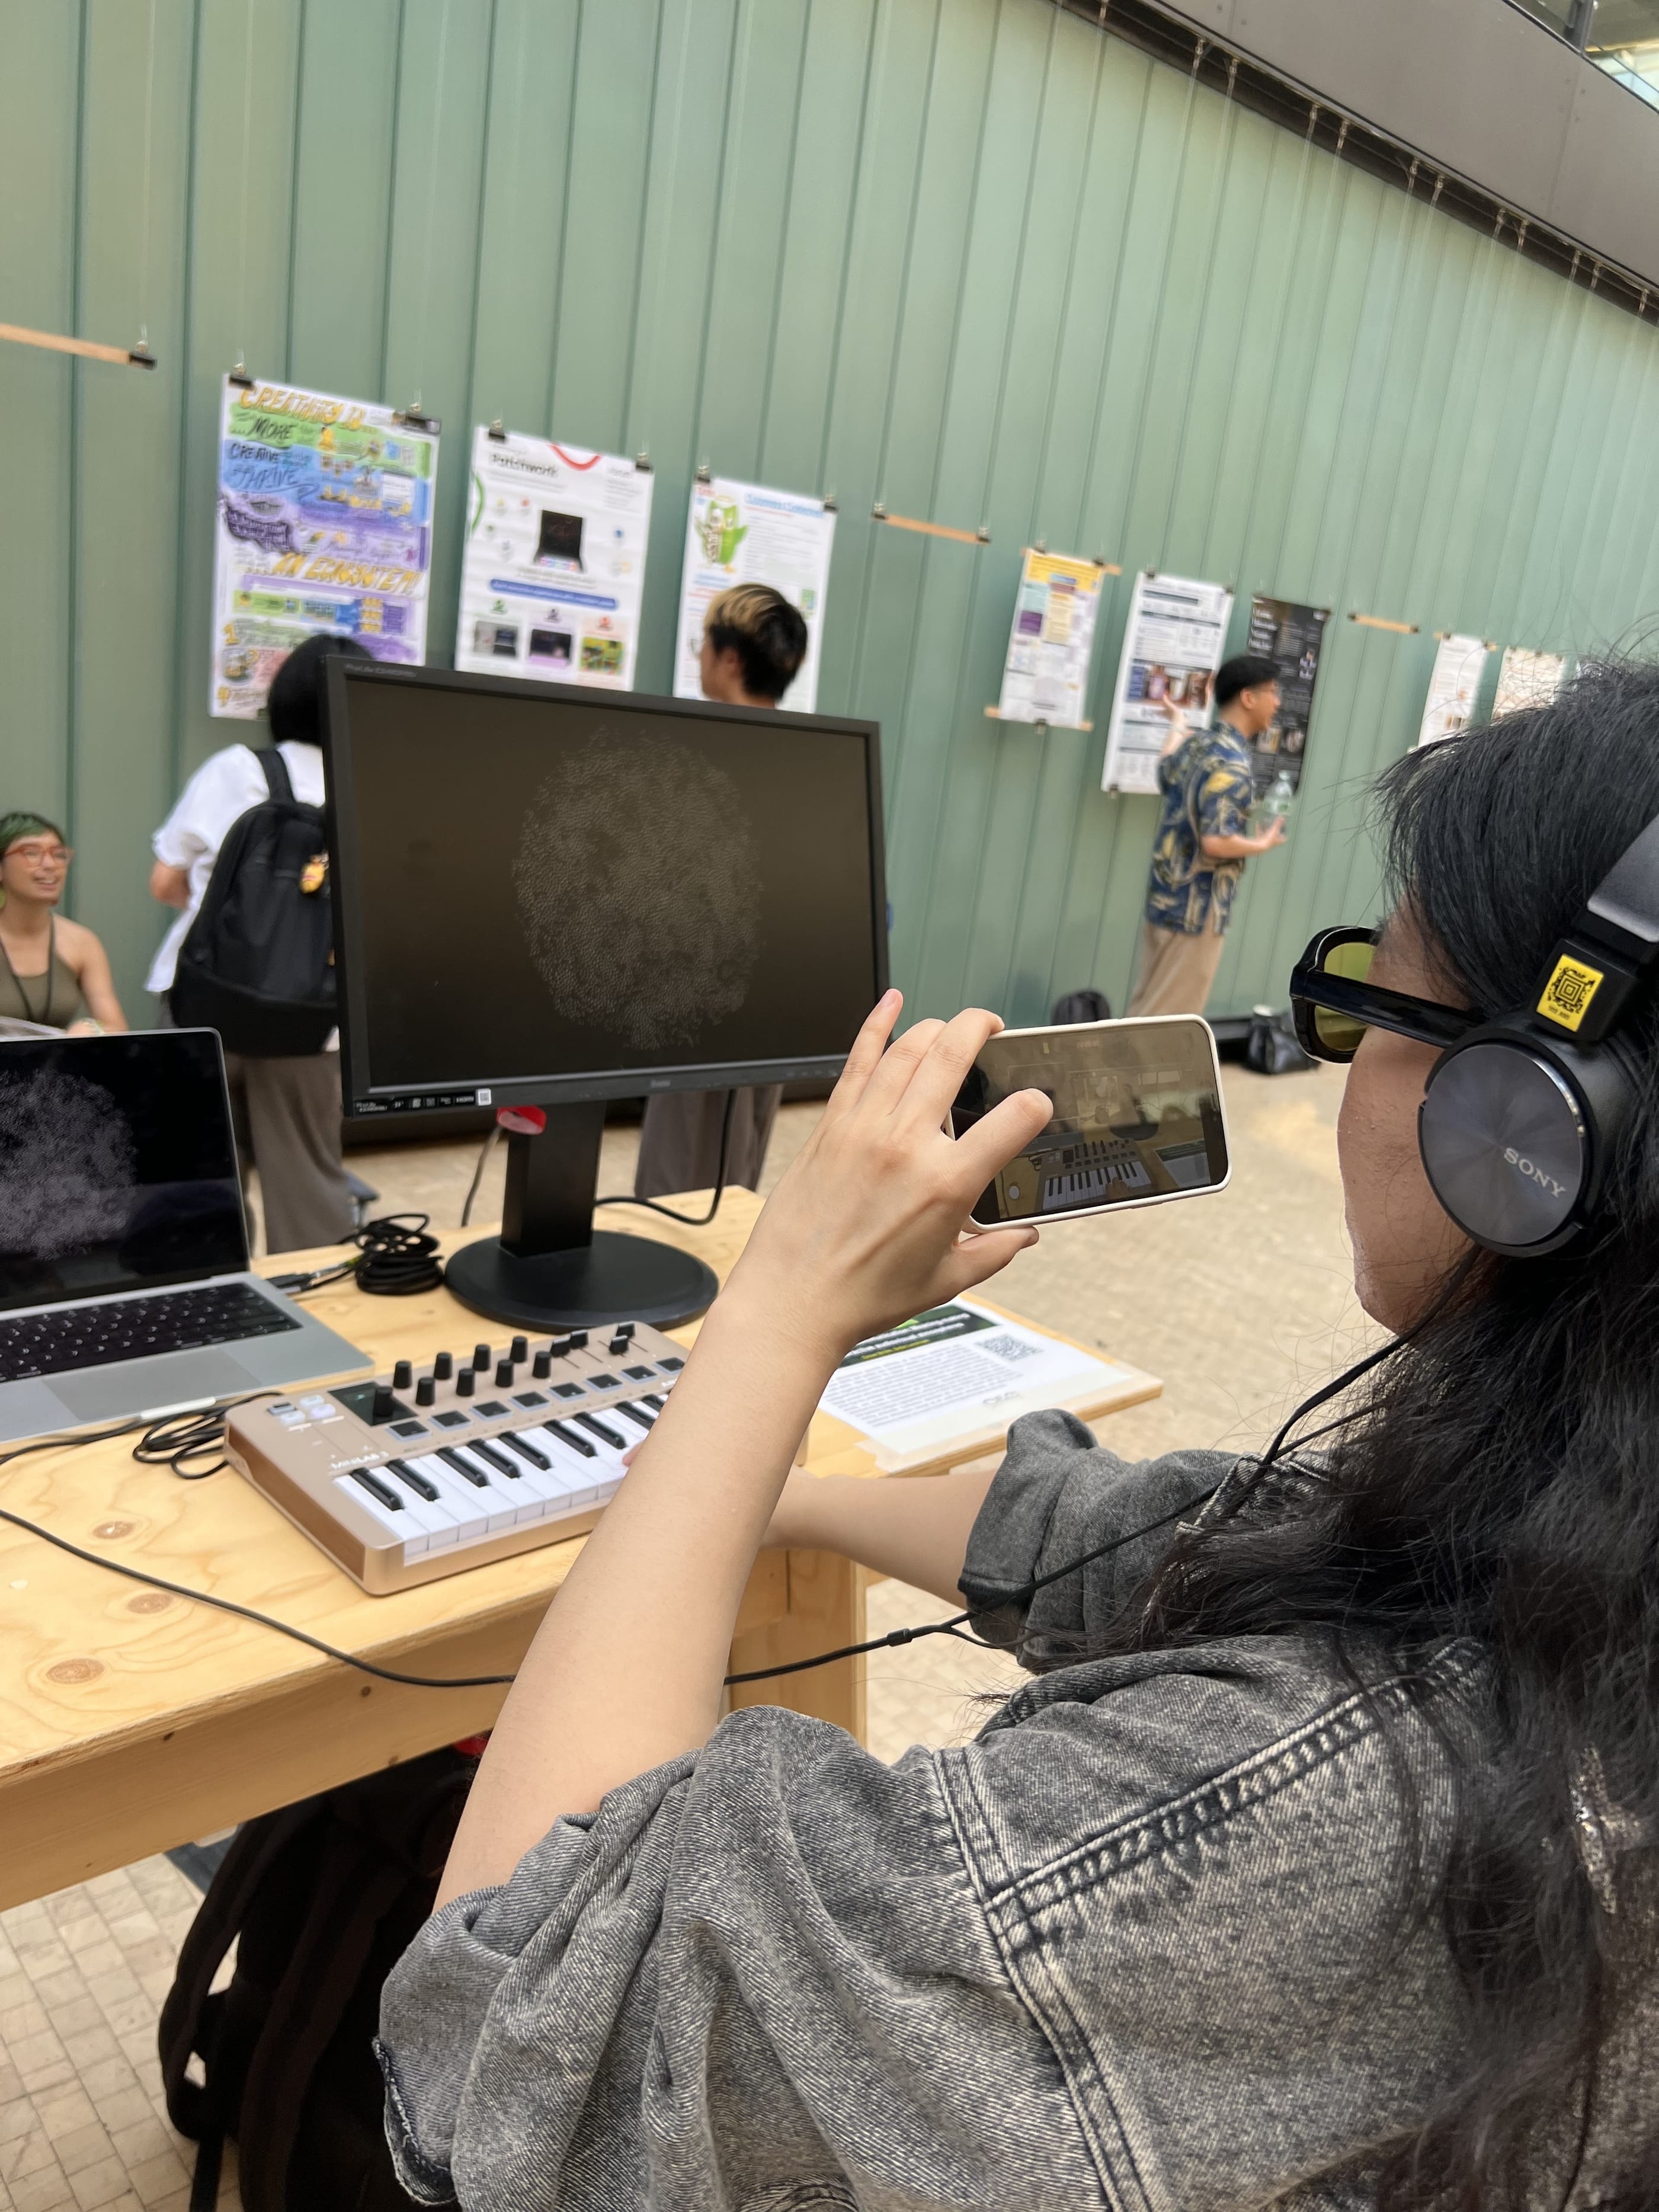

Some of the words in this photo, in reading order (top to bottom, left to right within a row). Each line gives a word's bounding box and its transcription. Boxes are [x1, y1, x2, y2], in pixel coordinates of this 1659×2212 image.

[240, 386, 345, 425] CREATIVITY
[246, 416, 298, 440] MORE
[229, 444, 280, 464] CREATIVE
[238, 464, 298, 489] THRIVE
[1503, 1147, 1566, 1198] SONY
